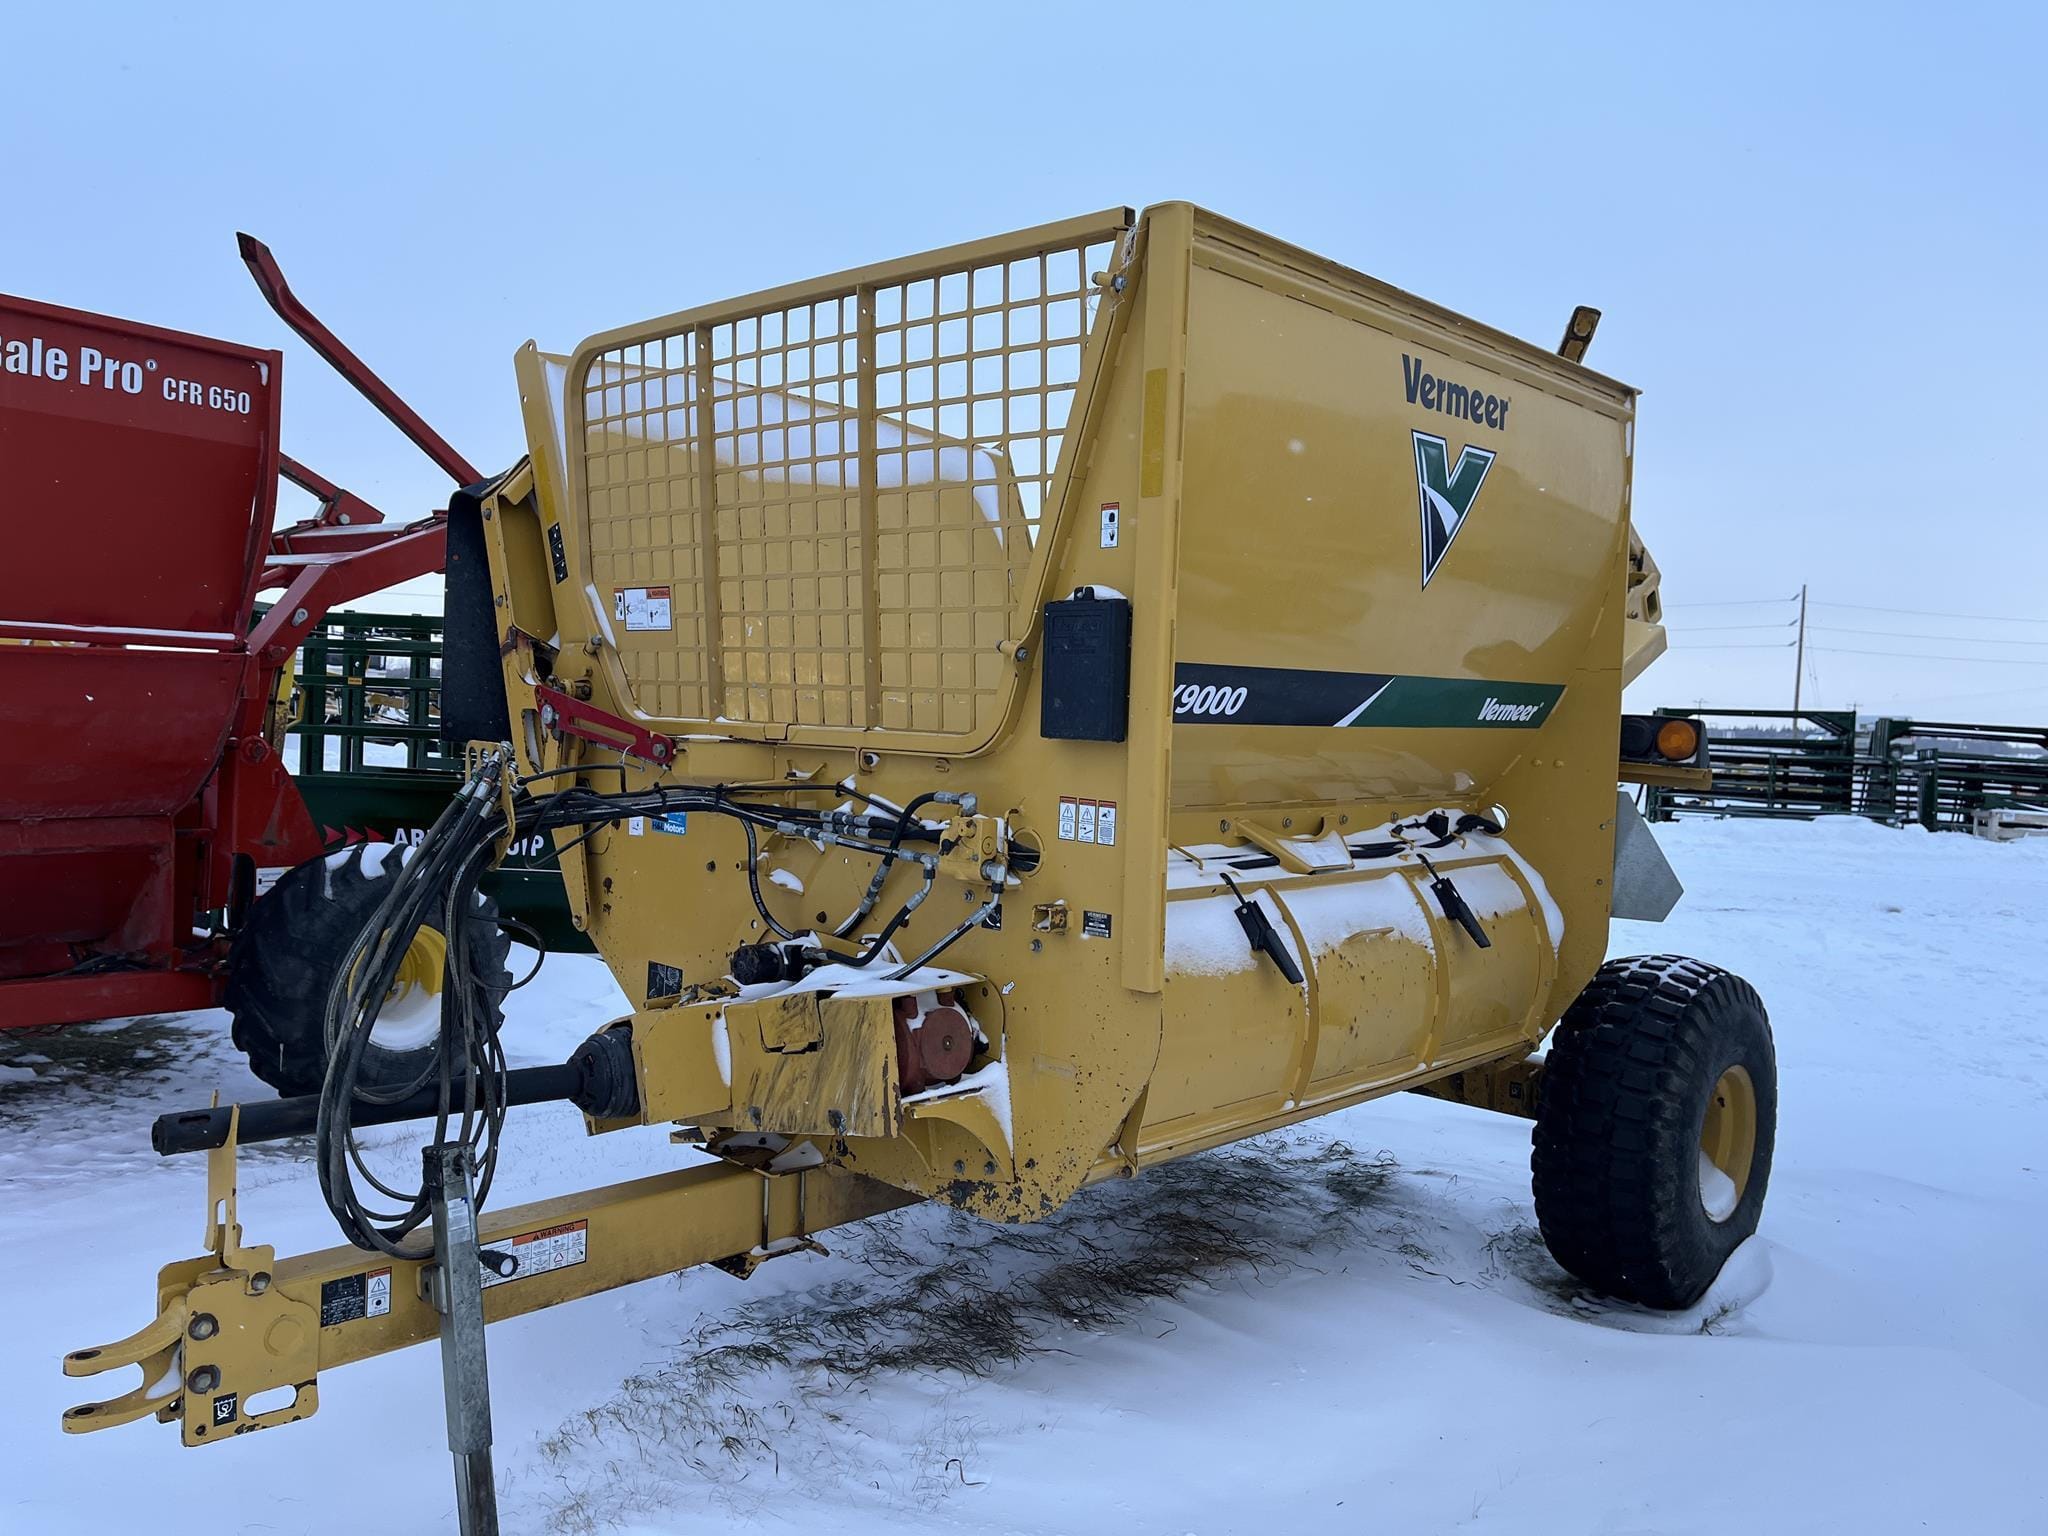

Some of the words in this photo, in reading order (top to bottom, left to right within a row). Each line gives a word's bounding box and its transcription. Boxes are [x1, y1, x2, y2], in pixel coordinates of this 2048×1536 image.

[0, 337, 68, 381] ale
[162, 376, 203, 406] CFR
[208, 386, 251, 415] 650
[1402, 353, 1508, 431] Vermeer
[1477, 697, 1540, 722] Vermeer
[540, 1224, 575, 1238] WARNING
